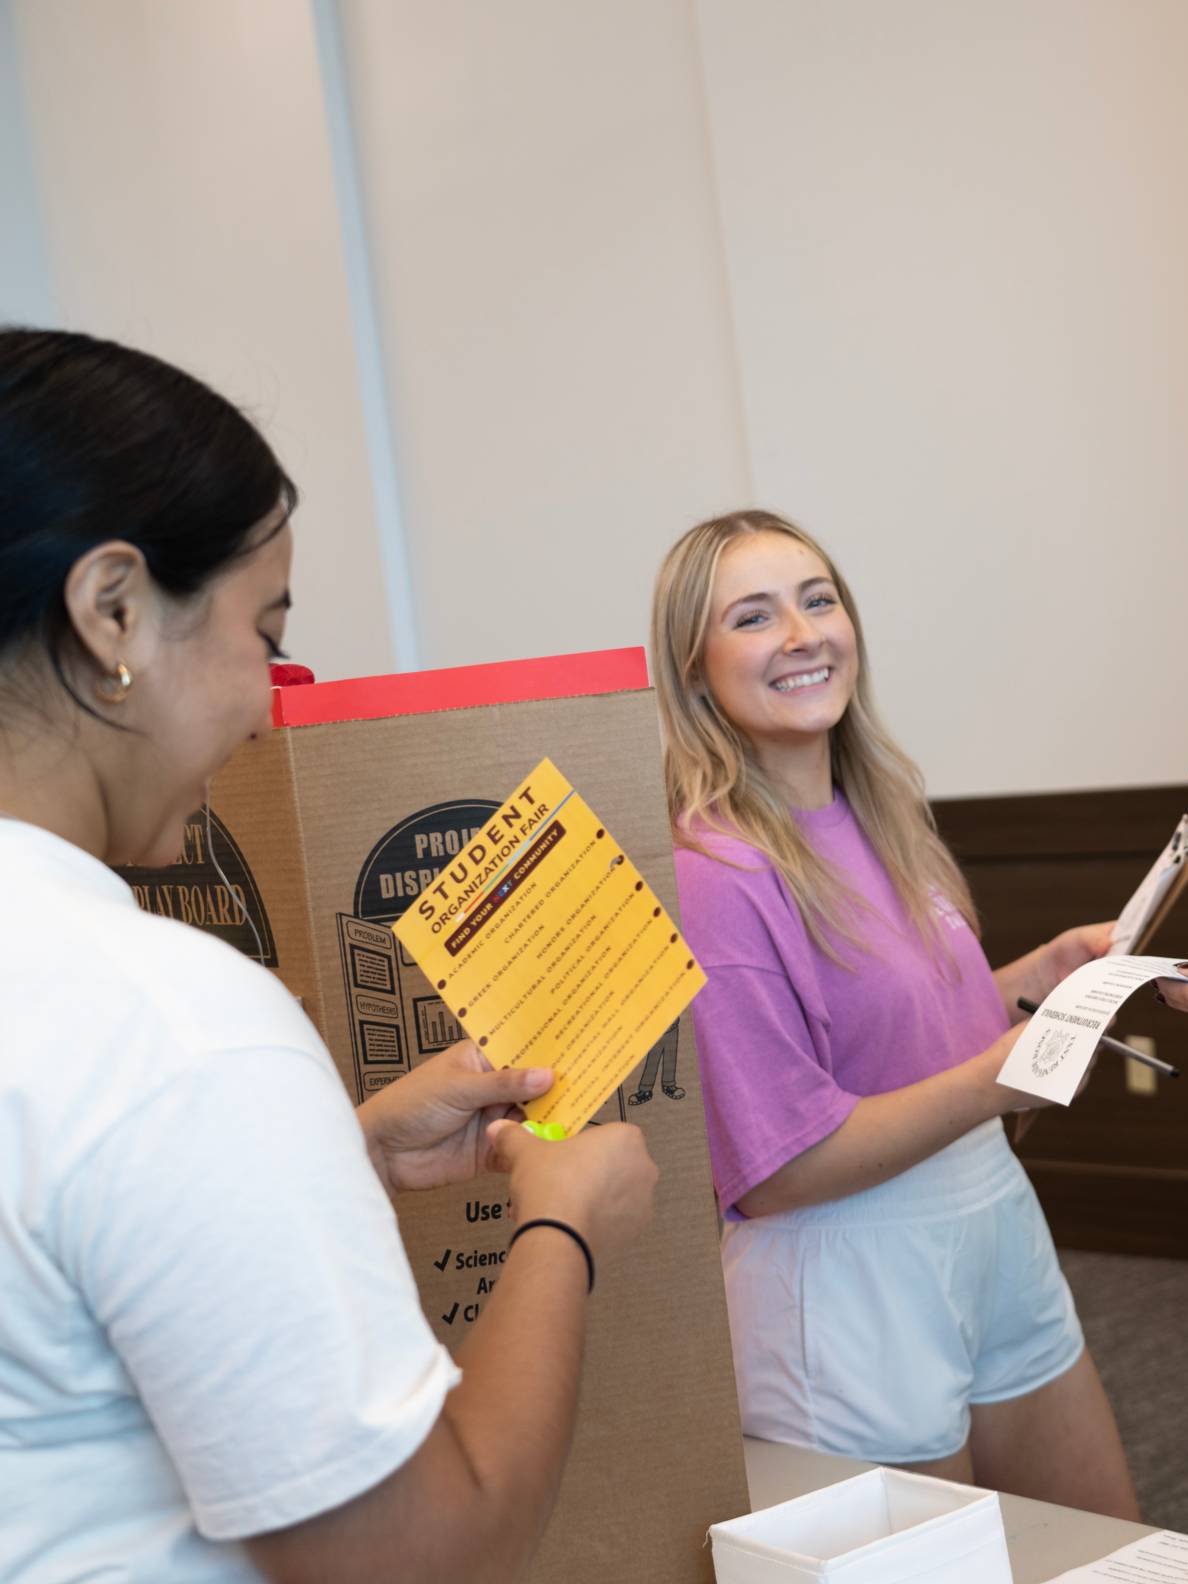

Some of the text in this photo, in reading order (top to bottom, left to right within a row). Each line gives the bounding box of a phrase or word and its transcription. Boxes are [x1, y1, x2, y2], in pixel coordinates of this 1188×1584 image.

[379, 867, 440, 899] DISP
[414, 827, 480, 859] PROJ
[417, 784, 538, 922] STUDENT
[430, 801, 549, 936] ORGANIZATION FAIR
[450, 925, 471, 950] FIND
[470, 901, 493, 927] YOUR
[512, 827, 559, 880] COMMUNITY
[503, 838, 597, 945] CHARTERED ORGANIZATION
[132, 884, 247, 926] PLAY BOARD
[354, 928, 386, 945] PROBLEM
[447, 880, 537, 980] ACADEMIC ORGANIZATION
[535, 864, 616, 960] HONORS ORGANIZATION
[549, 891, 635, 995] POLITICAL ORGANIZATION
[467, 922, 545, 1008] GREEK ORGANIZATION
[488, 912, 597, 1036] MULTICULTURAL ORGANIZATION
[510, 944, 612, 1066] PROFESSIONAL ORGANIZATION
[554, 917, 653, 1040] RECREATIONAL ORGANIZATION
[565, 988, 615, 1051] ORGANIZATION
[456, 1250, 507, 1270] Scienc
[466, 1200, 502, 1222] Use
